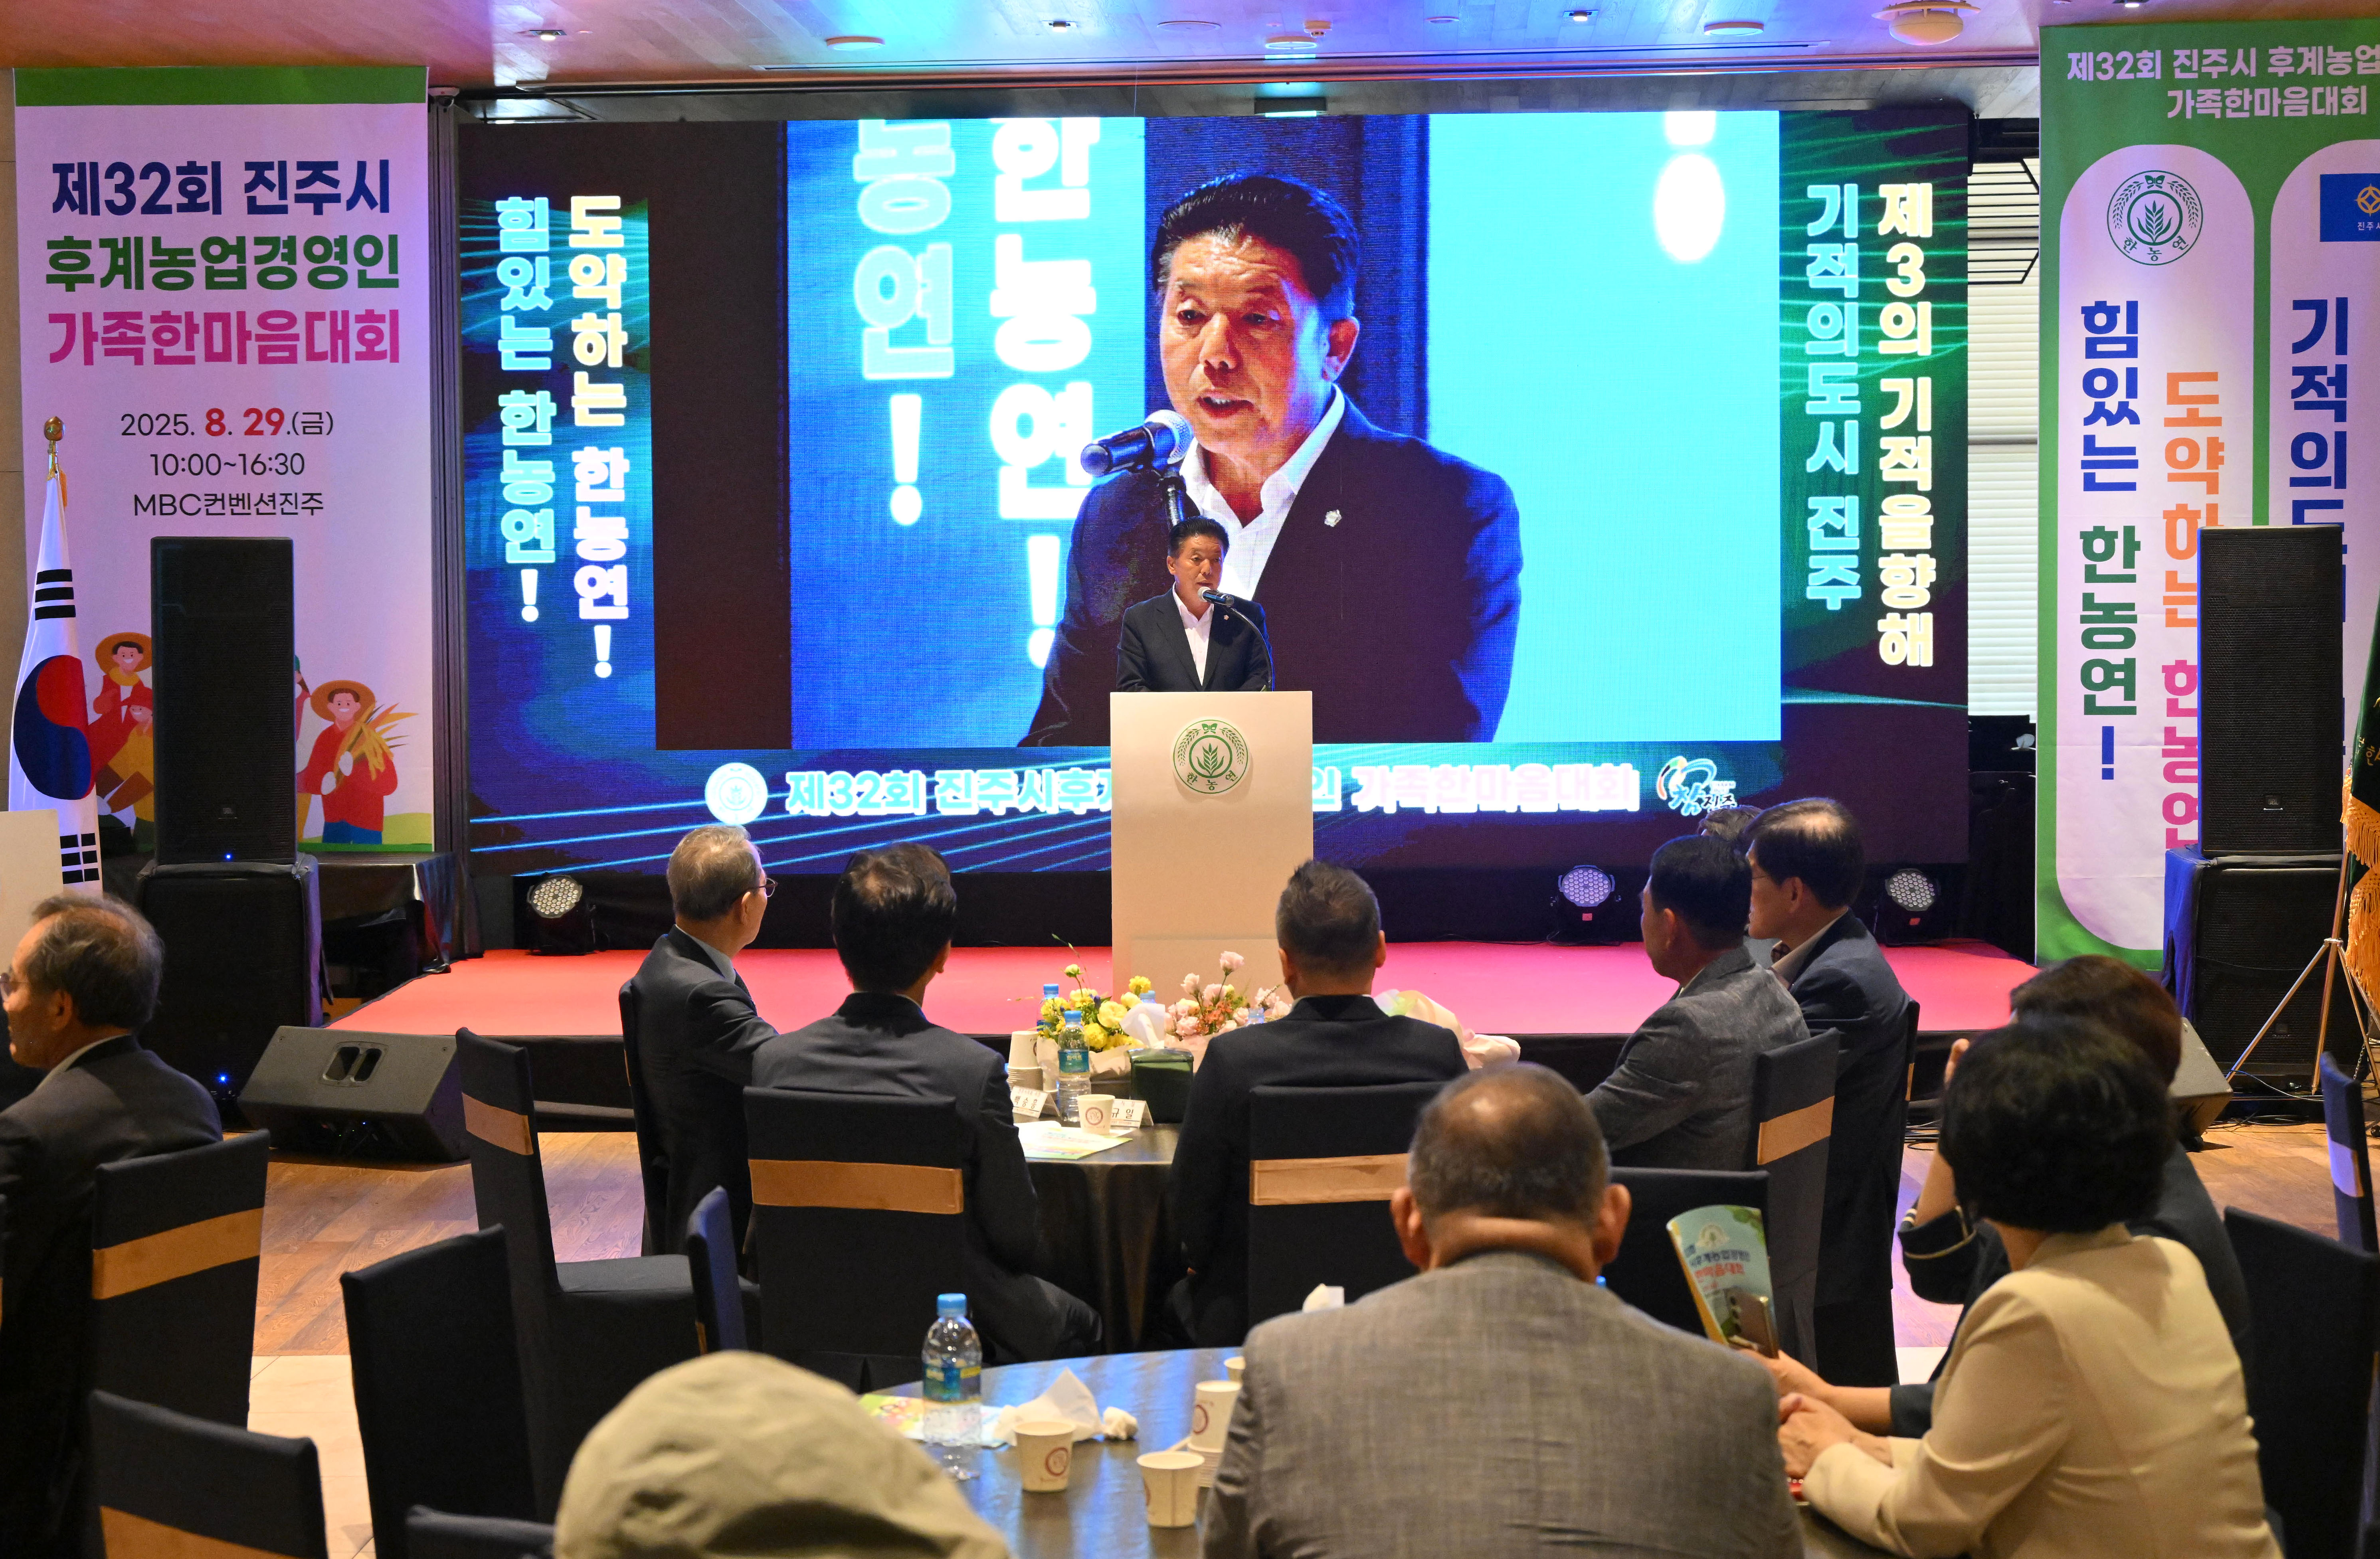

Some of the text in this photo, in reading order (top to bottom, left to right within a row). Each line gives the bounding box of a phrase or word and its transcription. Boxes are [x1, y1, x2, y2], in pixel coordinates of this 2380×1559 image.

[2067, 50, 2161, 81] 제32회
[2173, 47, 2256, 79] 진주시
[2167, 85, 2367, 119] 가족한마음대회
[52, 159, 390, 216] 제32회 진주시
[46, 234, 399, 292] 후계농업경영인
[1877, 182, 1933, 356] 제3의
[48, 309, 399, 366] 가족한마음대회
[121, 413, 195, 437] 2025.
[205, 408, 232, 437] 8.
[496, 196, 556, 622] 힘있는 한농연!
[2080, 300, 2141, 492] 힘있는
[150, 452, 305, 476] 10:00~16:30
[568, 196, 630, 678] 도약하는 한농연!
[134, 492, 324, 516] MBC컨벤션진주
[1806, 495, 1862, 611] 진주
[785, 769, 926, 817] 제32회
[935, 768, 1112, 816] 진주시후
[1350, 763, 1640, 814] 가족한마음대회
